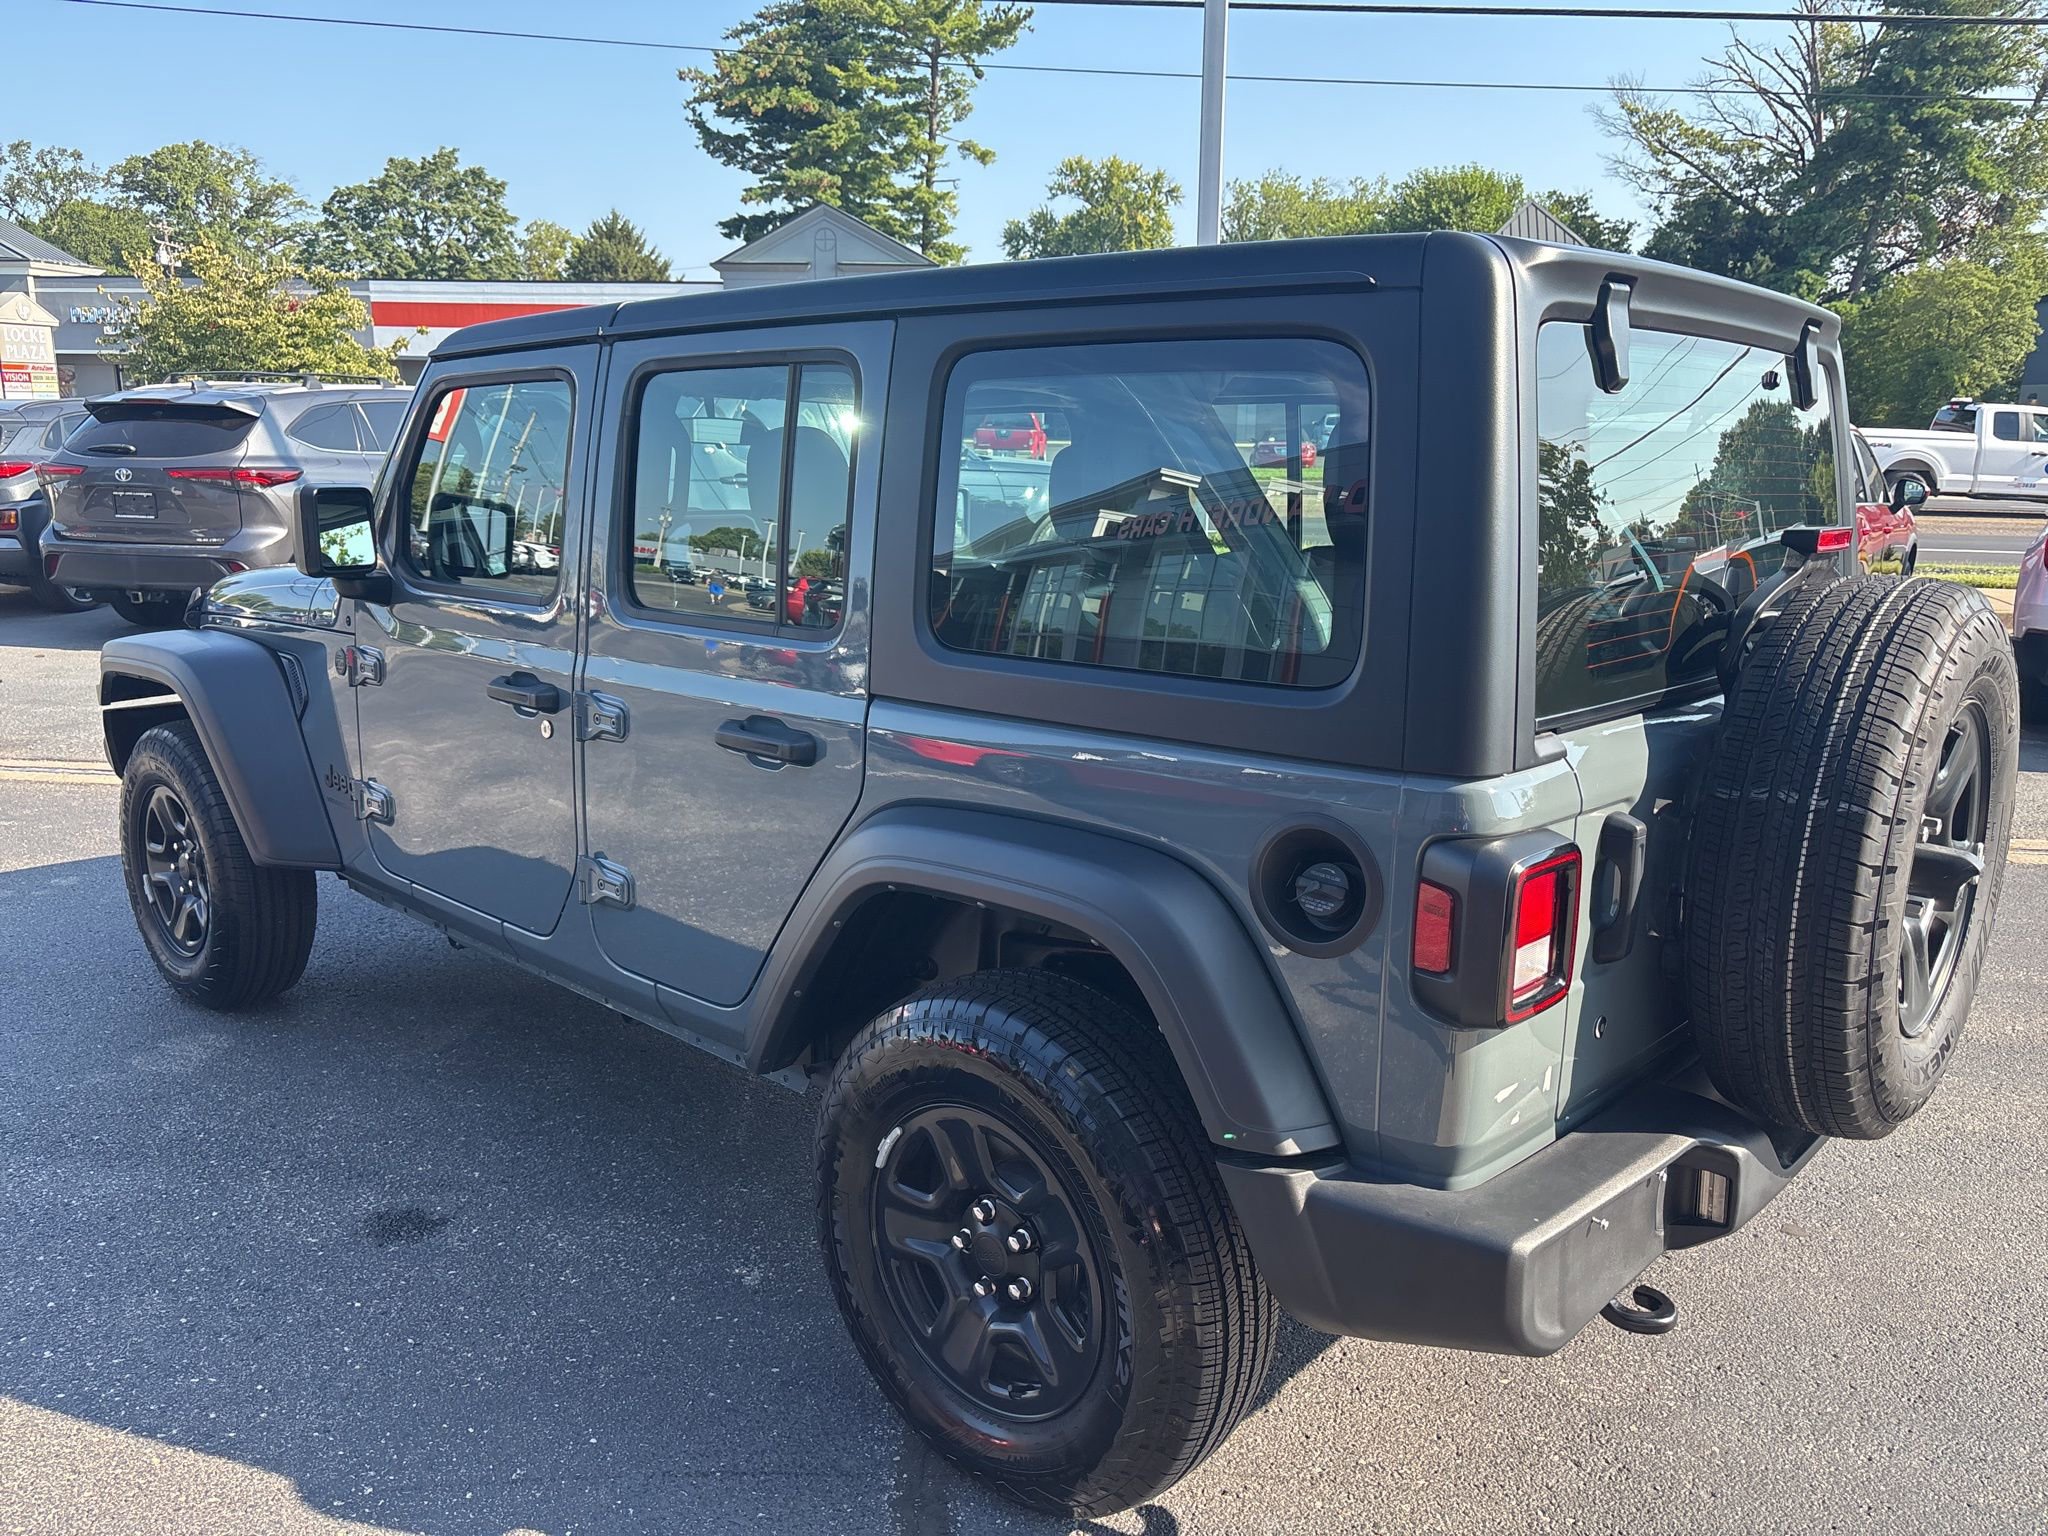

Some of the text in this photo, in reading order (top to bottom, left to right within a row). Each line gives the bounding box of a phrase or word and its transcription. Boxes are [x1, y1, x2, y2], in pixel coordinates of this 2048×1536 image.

[3, 327, 47, 343] LOCKE
[6, 344, 48, 360] PLAZA
[4, 373, 29, 381] VISION
